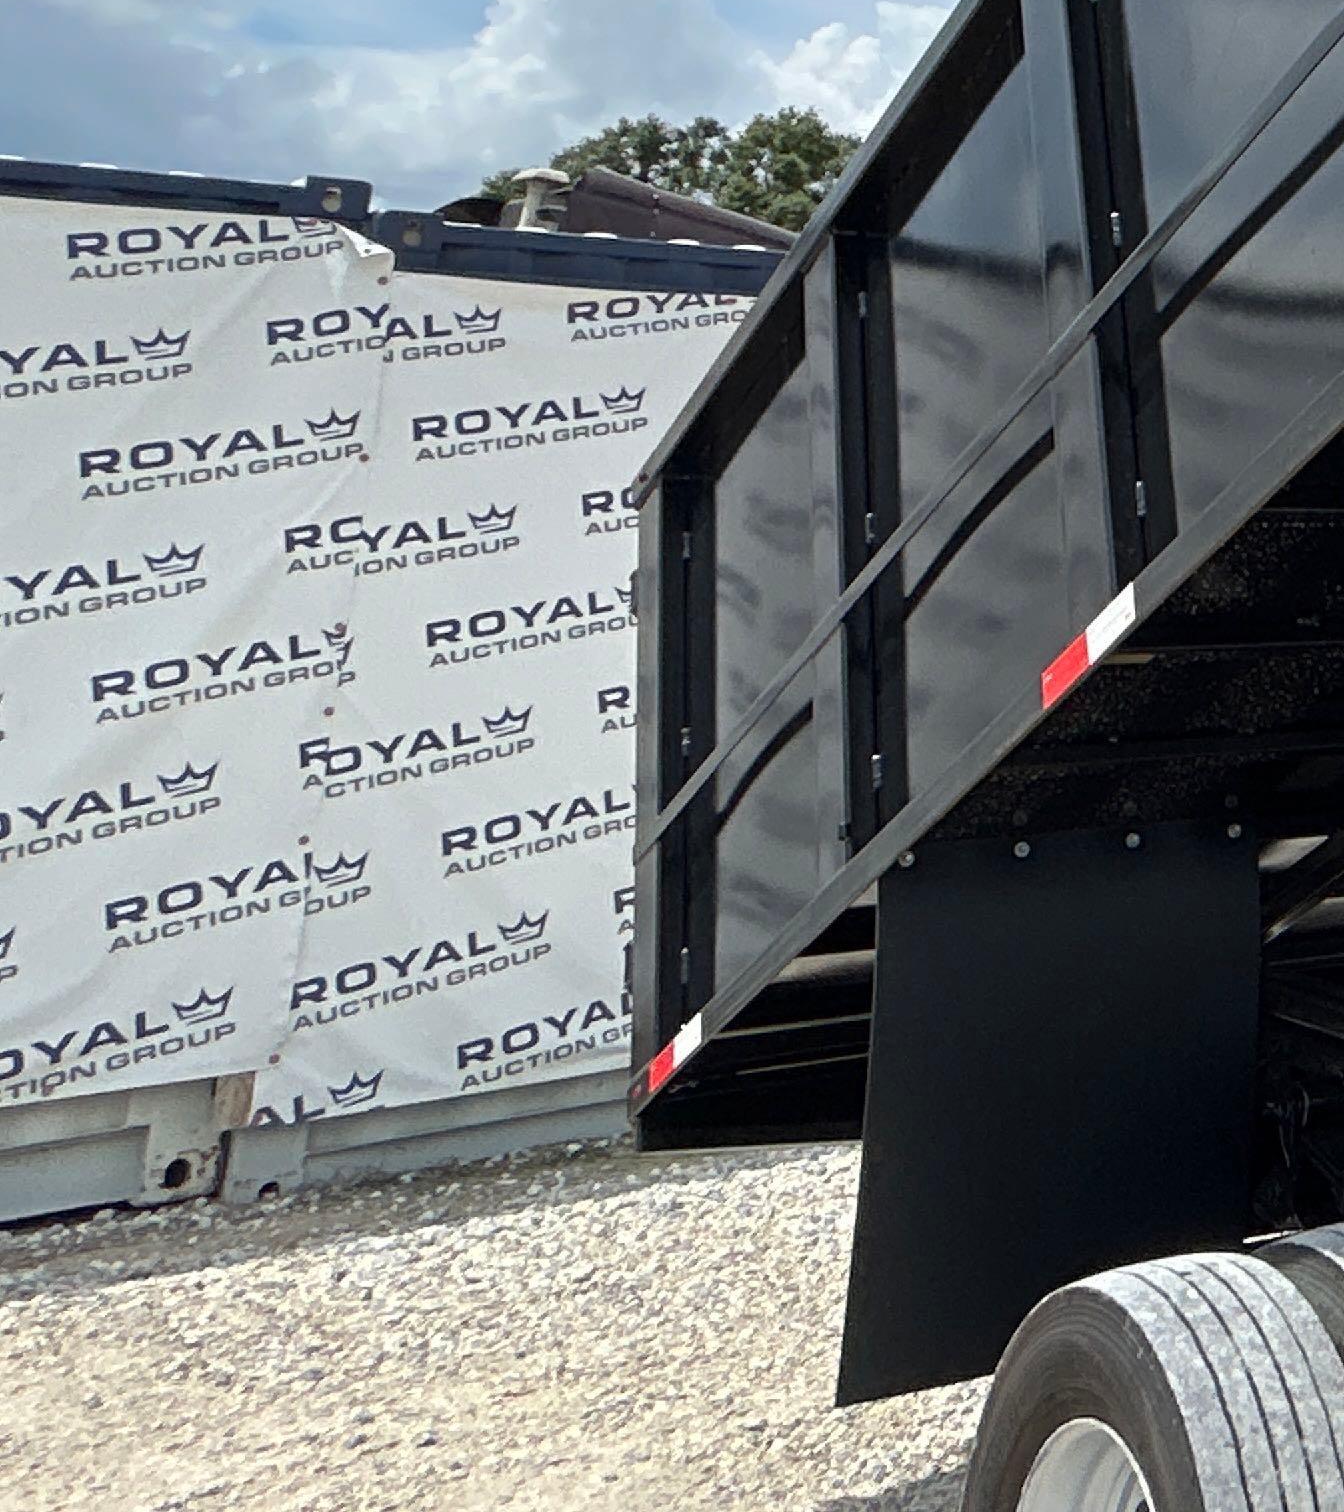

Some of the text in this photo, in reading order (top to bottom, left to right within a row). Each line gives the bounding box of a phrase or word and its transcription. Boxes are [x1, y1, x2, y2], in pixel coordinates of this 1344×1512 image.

[66, 219, 289, 259] ROYAL
[69, 240, 344, 281] AUCTION GROUP
[266, 303, 452, 345] ROYAL
[402, 337, 506, 362] GROUP
[570, 309, 748, 342] AUCTION GRO
[0, 340, 129, 375] YAL
[66, 363, 192, 392] GROUP
[412, 396, 600, 441] ROYAL
[415, 417, 649, 462] AUCTION GROUP
[79, 424, 304, 478] ROYAL
[81, 442, 364, 500] AUCTION GROUP
[4, 559, 141, 600] YAL
[286, 536, 520, 577] AUCION GROUP
[78, 577, 207, 614] GROUP
[425, 592, 615, 647] ROYAL
[91, 634, 321, 702] ROYAL
[429, 615, 637, 668] AUCTION GRO
[96, 658, 356, 724] AUCTION GROP
[302, 738, 535, 799] ACTION GROUP
[0, 782, 155, 839] YAL
[0, 796, 222, 863] TION GROUP
[441, 789, 630, 857] ROYAL
[443, 814, 636, 879] AUCTION GRO
[109, 886, 371, 953] AUCTION GOUP
[290, 931, 497, 1010] ROYAL
[293, 942, 551, 1031] AUCTION GROUP
[0, 1011, 169, 1081] OYAL
[5, 1022, 236, 1100] TION GROUP
[461, 1036, 596, 1091] AUCTION
